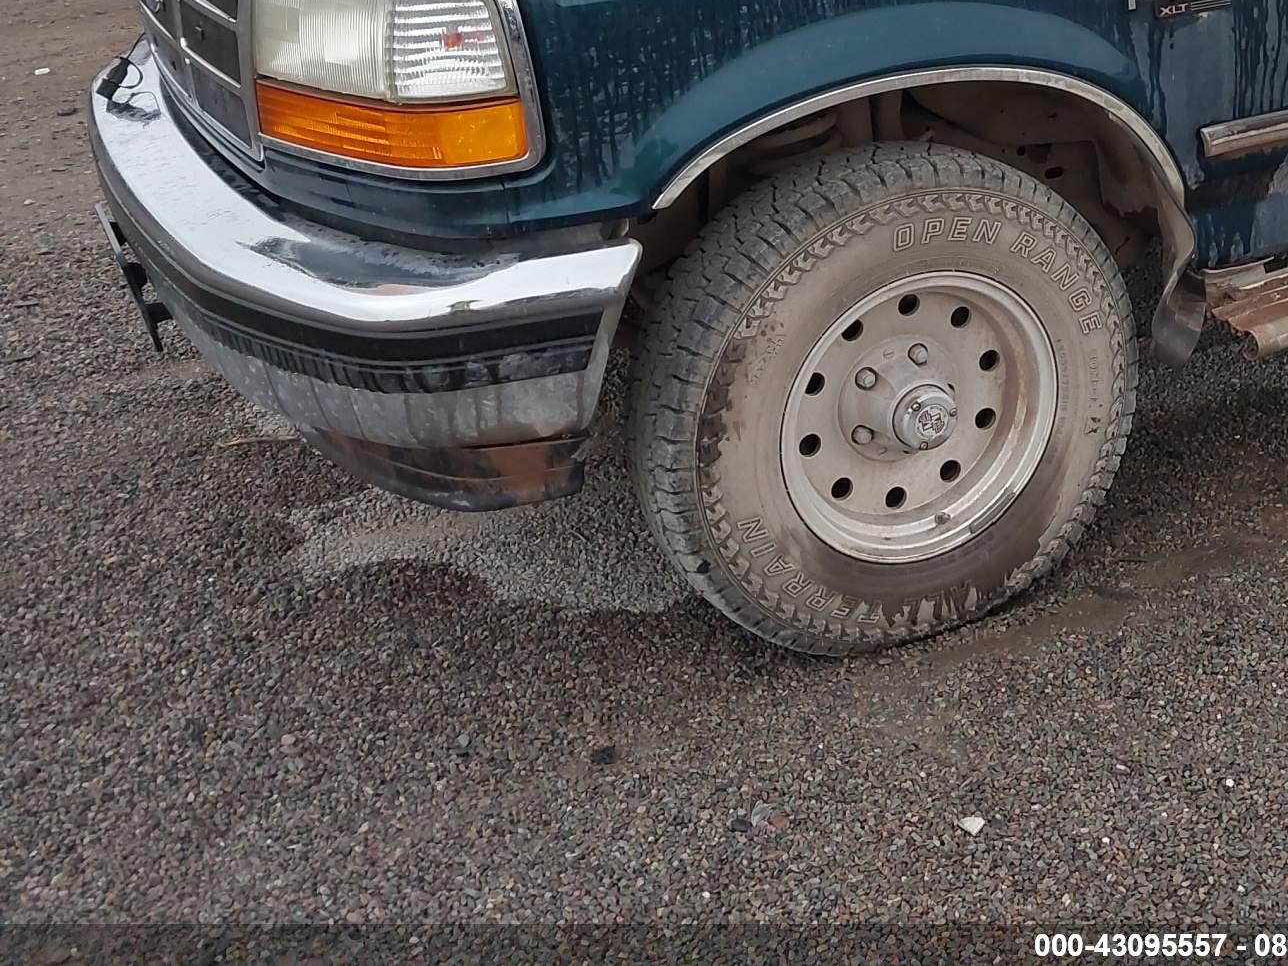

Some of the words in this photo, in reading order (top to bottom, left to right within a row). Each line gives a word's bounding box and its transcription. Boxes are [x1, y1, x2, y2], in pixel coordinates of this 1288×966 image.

[1160, 3, 1190, 18] XLT
[893, 217, 1001, 252] OPEN
[1010, 231, 1103, 334] RANGE
[737, 517, 882, 624] TERRAIN
